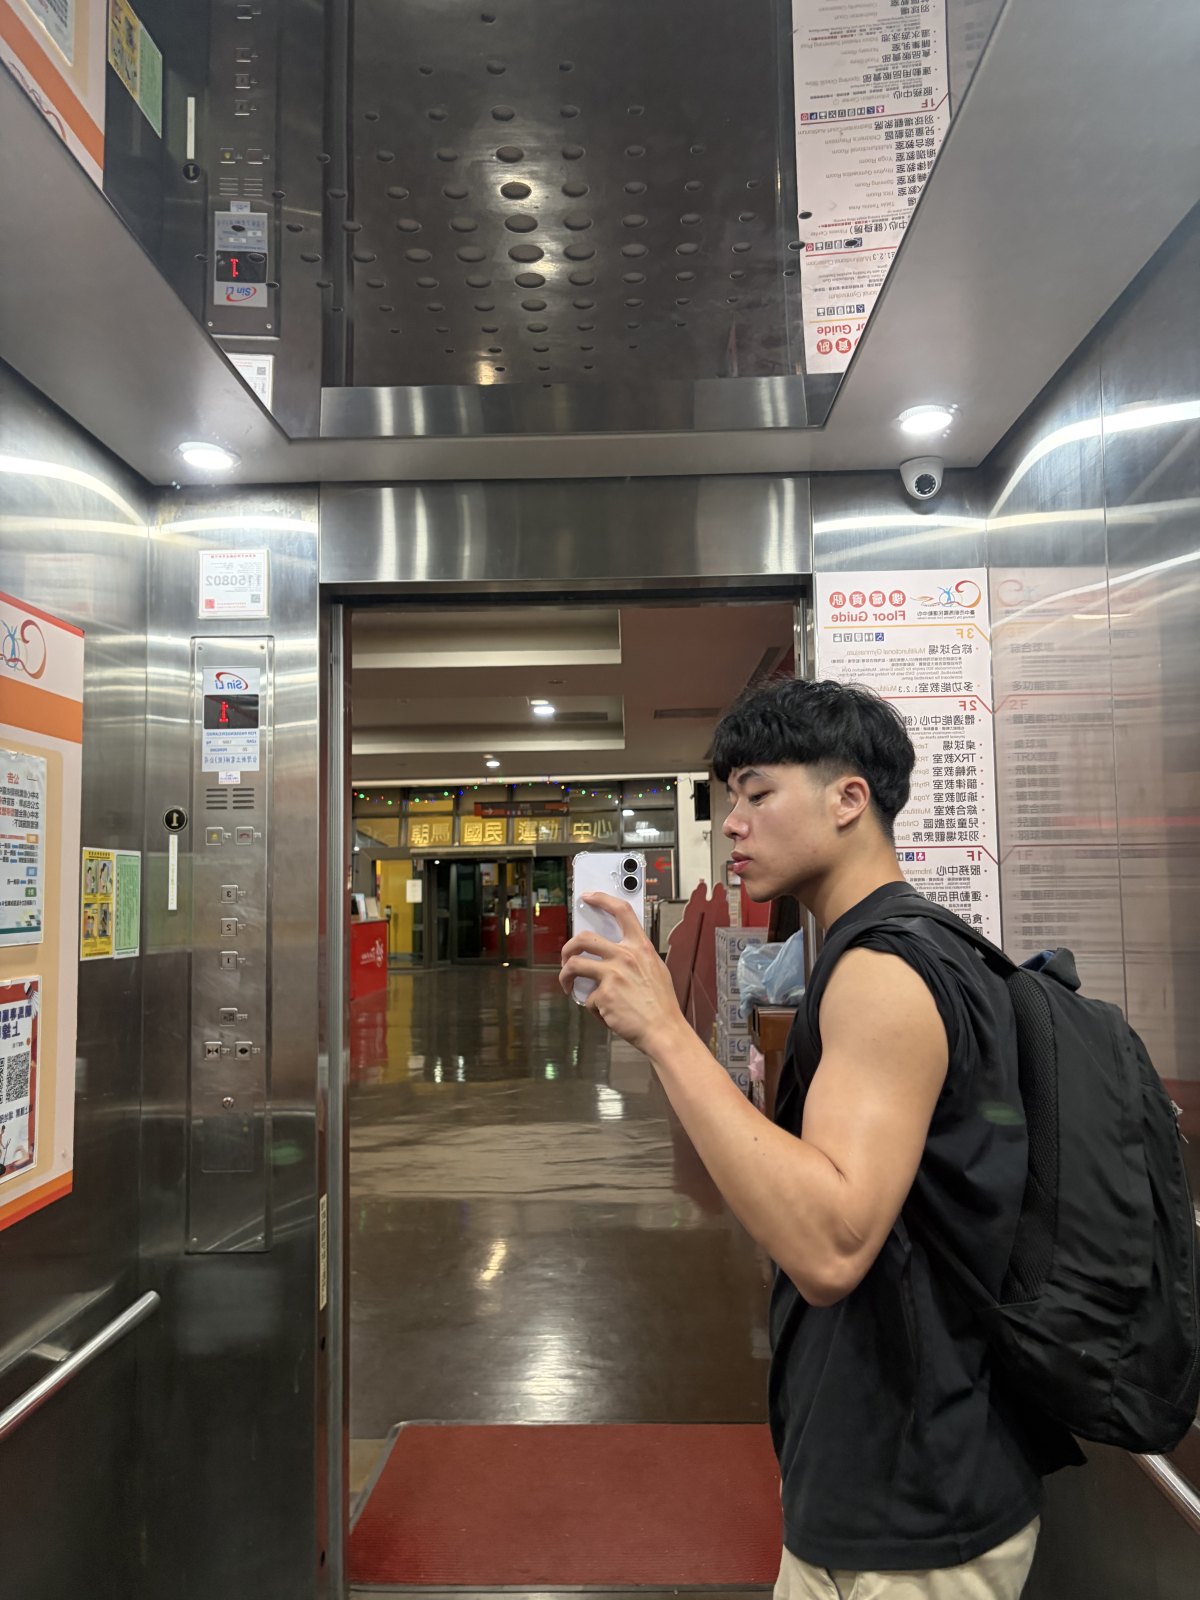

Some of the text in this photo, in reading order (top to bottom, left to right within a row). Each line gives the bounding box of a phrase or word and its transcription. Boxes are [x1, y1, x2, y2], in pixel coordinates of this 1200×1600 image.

[900, 4, 930, 15] 羽球場
[863, 66, 931, 83] 運動用品販賣部
[893, 87, 932, 99] 服務中心
[921, 98, 935, 108] 1F
[884, 126, 934, 140] 兒童遊戲區
[895, 138, 934, 150] 綜合教室
[896, 172, 929, 185] 輪教室
[230, 258, 239, 277] 1
[237, 287, 251, 296] Sin
[817, 325, 851, 335] Guide
[817, 338, 851, 355] 資訊
